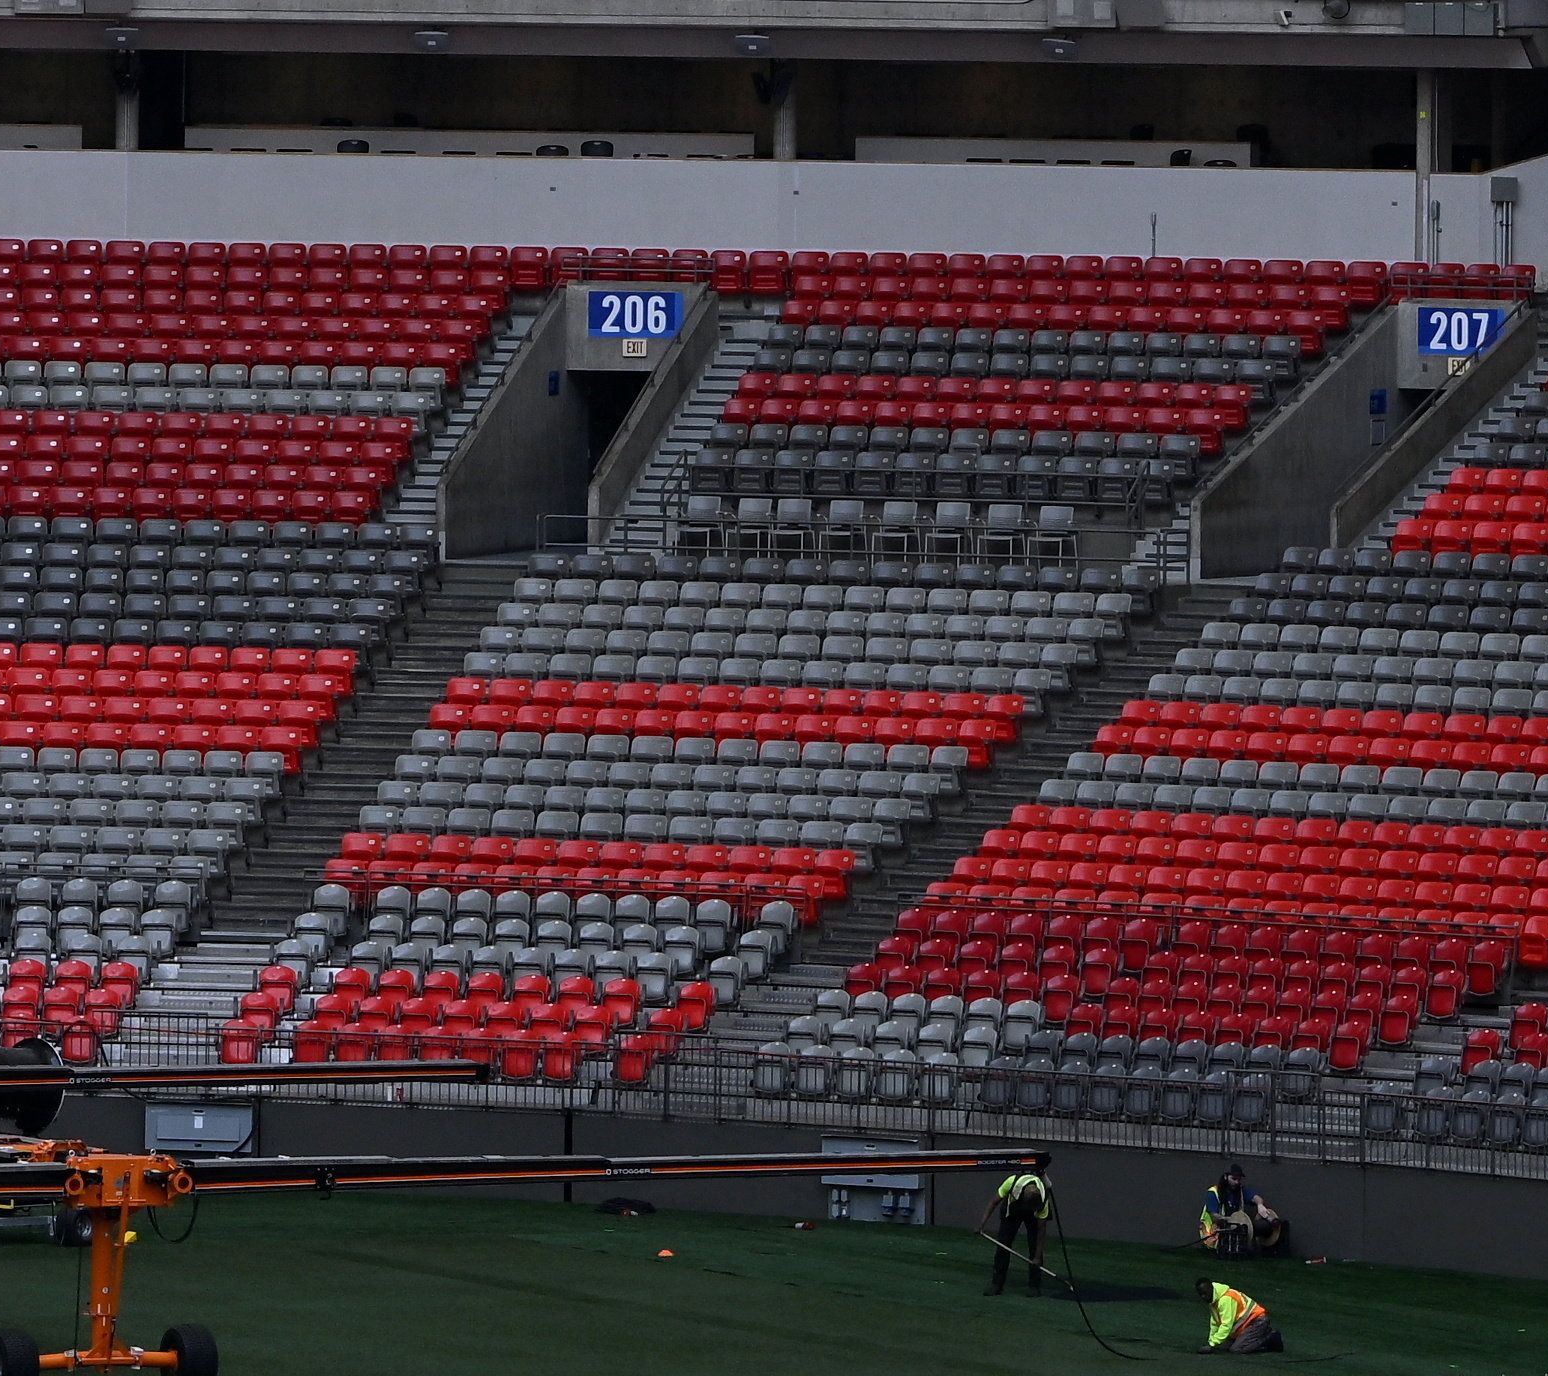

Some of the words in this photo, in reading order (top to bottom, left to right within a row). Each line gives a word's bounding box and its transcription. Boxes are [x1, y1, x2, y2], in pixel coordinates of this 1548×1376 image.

[602, 296, 665, 333] 206
[1430, 312, 1488, 350] 207
[627, 341, 644, 354] EXIT
